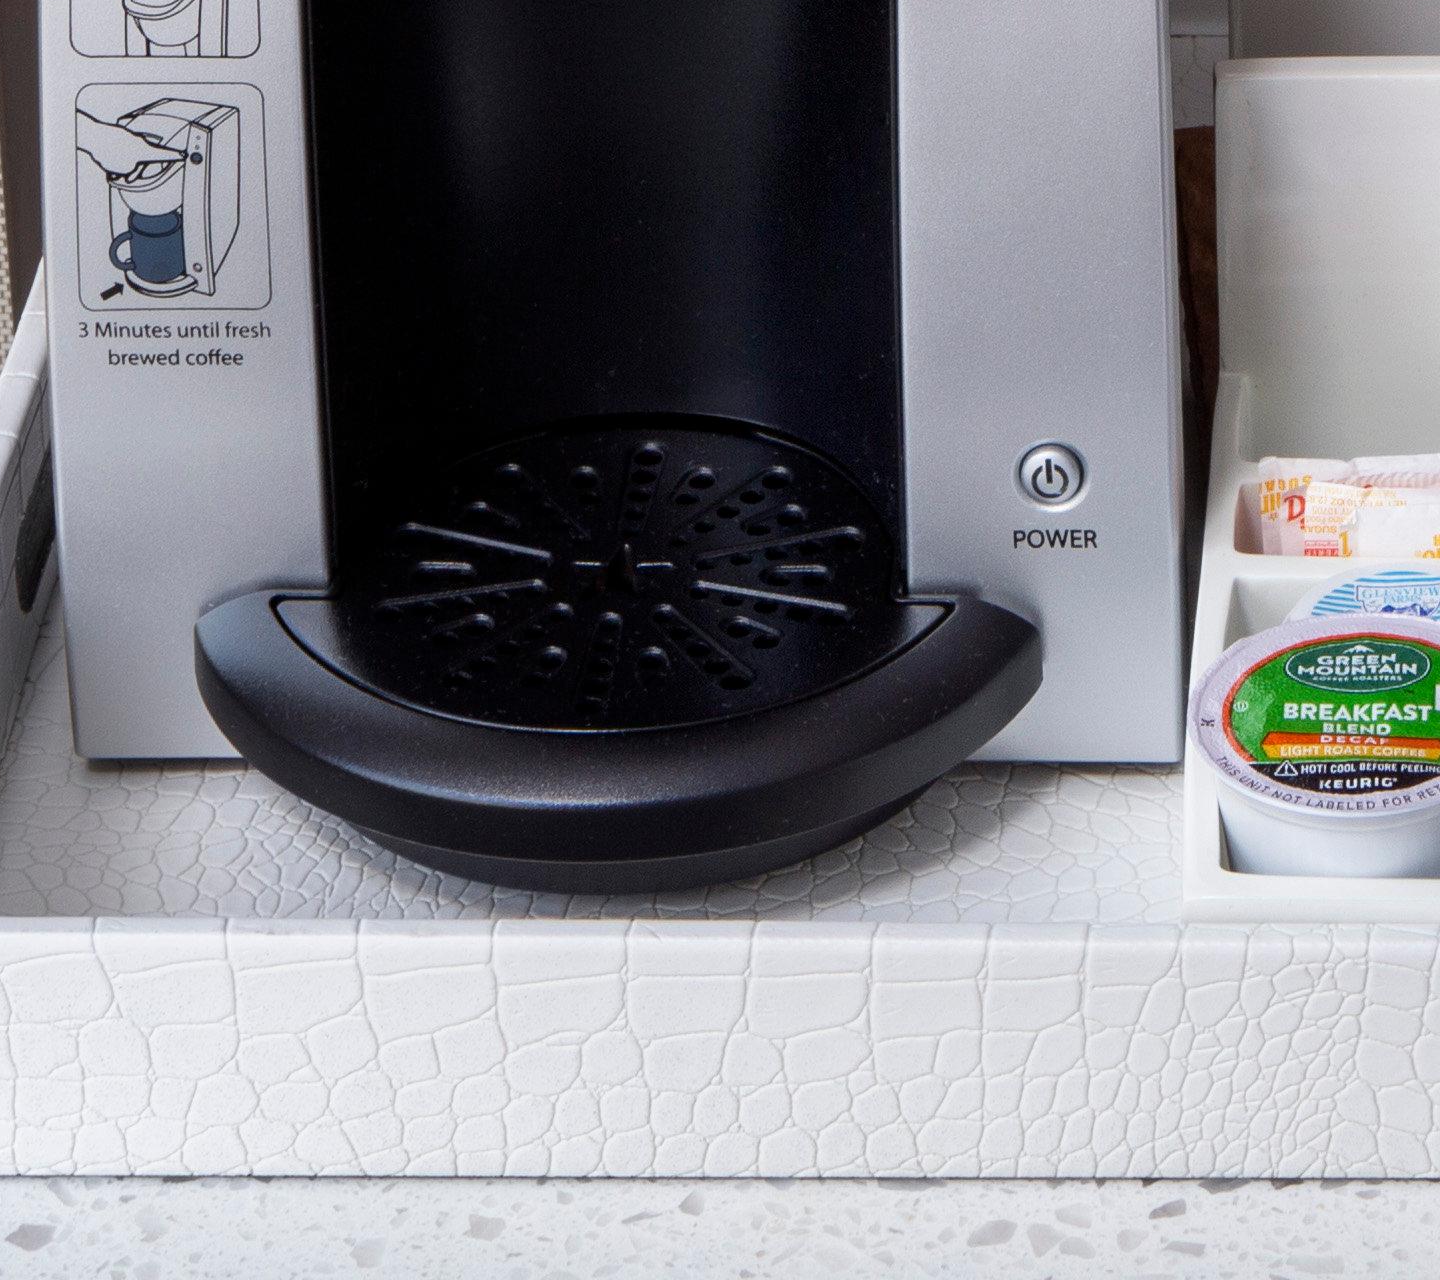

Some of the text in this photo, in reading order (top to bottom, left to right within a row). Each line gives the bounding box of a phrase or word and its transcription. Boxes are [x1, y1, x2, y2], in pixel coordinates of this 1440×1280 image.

[78, 321, 272, 338] 3 Minutes until fresh
[108, 348, 244, 366] brewed coffee
[1013, 529, 1098, 549] POWER
[1317, 653, 1396, 666] GREEN
[1297, 663, 1418, 677] MOUNTAIN
[1354, 674, 1402, 682] ROASTERS
[1283, 703, 1433, 722] BREAKFAST
[1322, 722, 1392, 736] BLEND
[1320, 735, 1389, 745] DECAF
[1280, 745, 1426, 758] LIGHT ROAST COFFEE
[1301, 763, 1328, 774] HOT!
[1330, 763, 1356, 774] COOL
[1359, 762, 1398, 773] BEFORE
[1217, 756, 1240, 777] THIS
[1238, 775, 1271, 794] UNIT
[1272, 790, 1301, 805] NOT
[1306, 798, 1376, 811] LABELED
[1382, 795, 1413, 808] FOR
